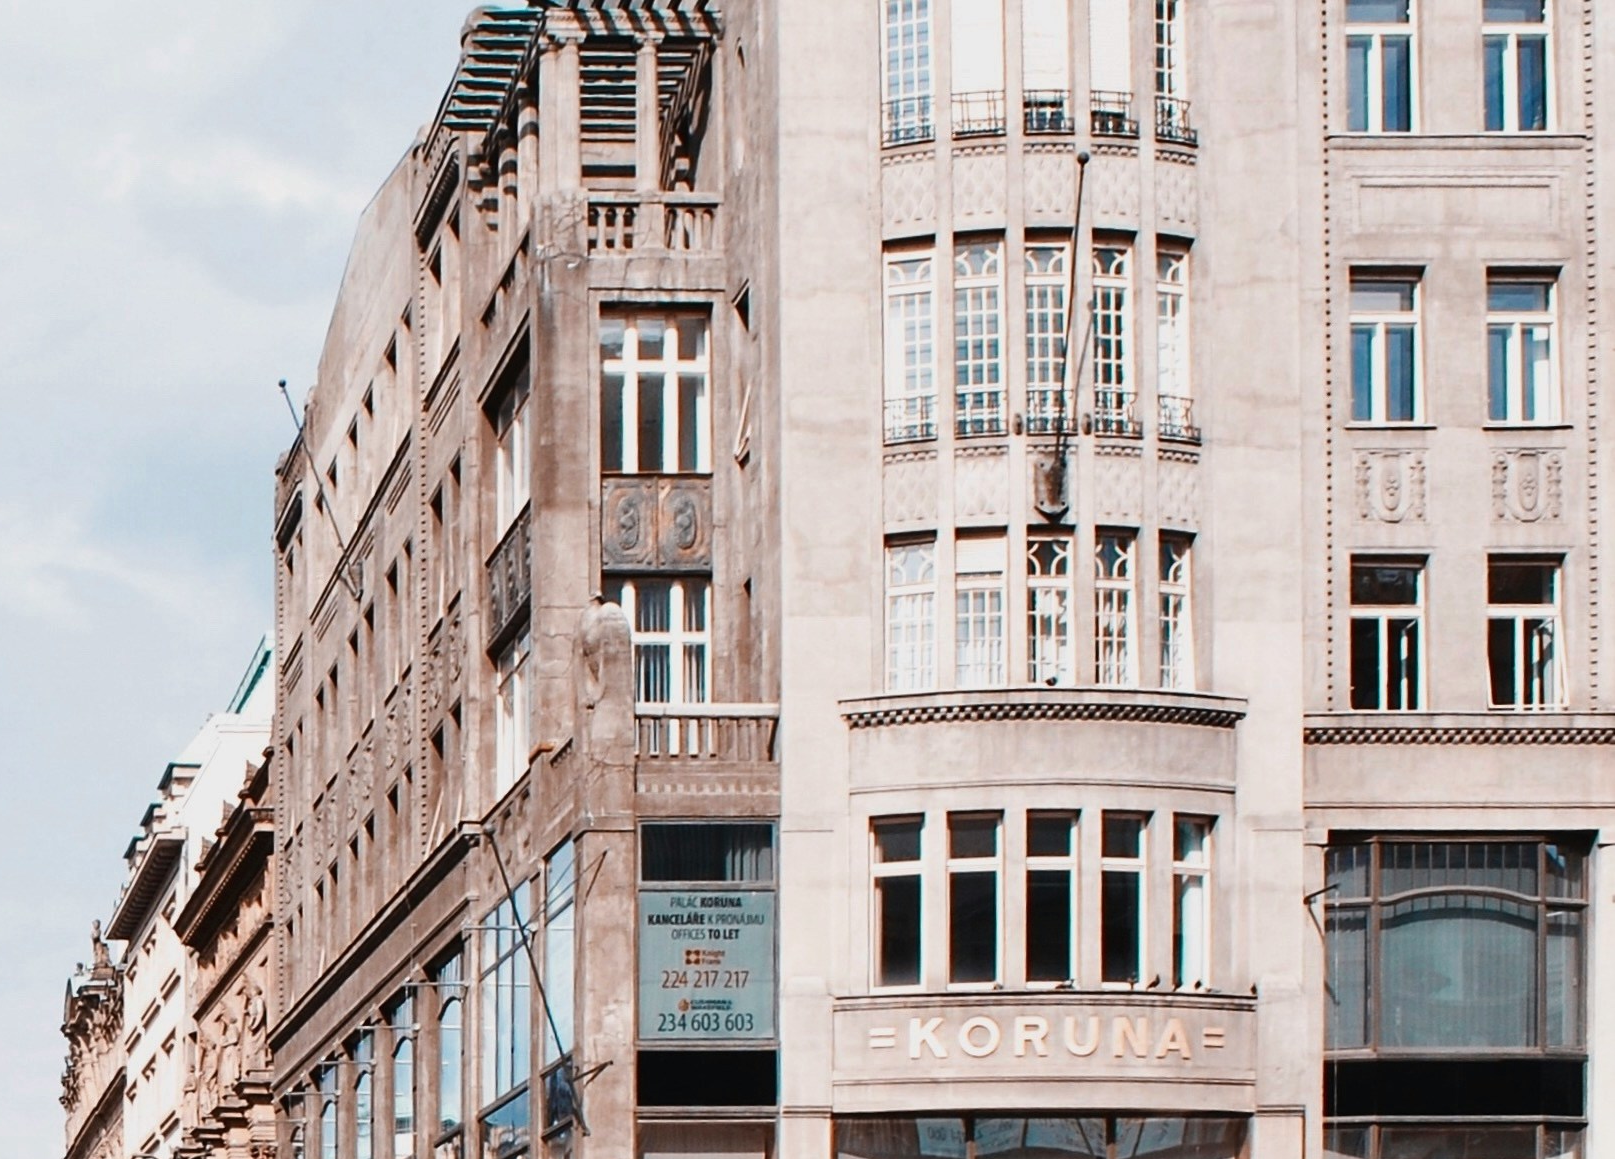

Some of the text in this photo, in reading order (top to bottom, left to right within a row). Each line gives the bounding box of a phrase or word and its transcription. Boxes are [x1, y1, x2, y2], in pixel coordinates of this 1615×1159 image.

[700, 897, 743, 908] KORUNA
[647, 912, 705, 925] KANCELÁŘE
[671, 929, 740, 940] OFFICES TO LET
[661, 970, 750, 989] 224 217 217
[657, 1013, 754, 1032] 234 603 603
[908, 1015, 1192, 1060] KORUNA
